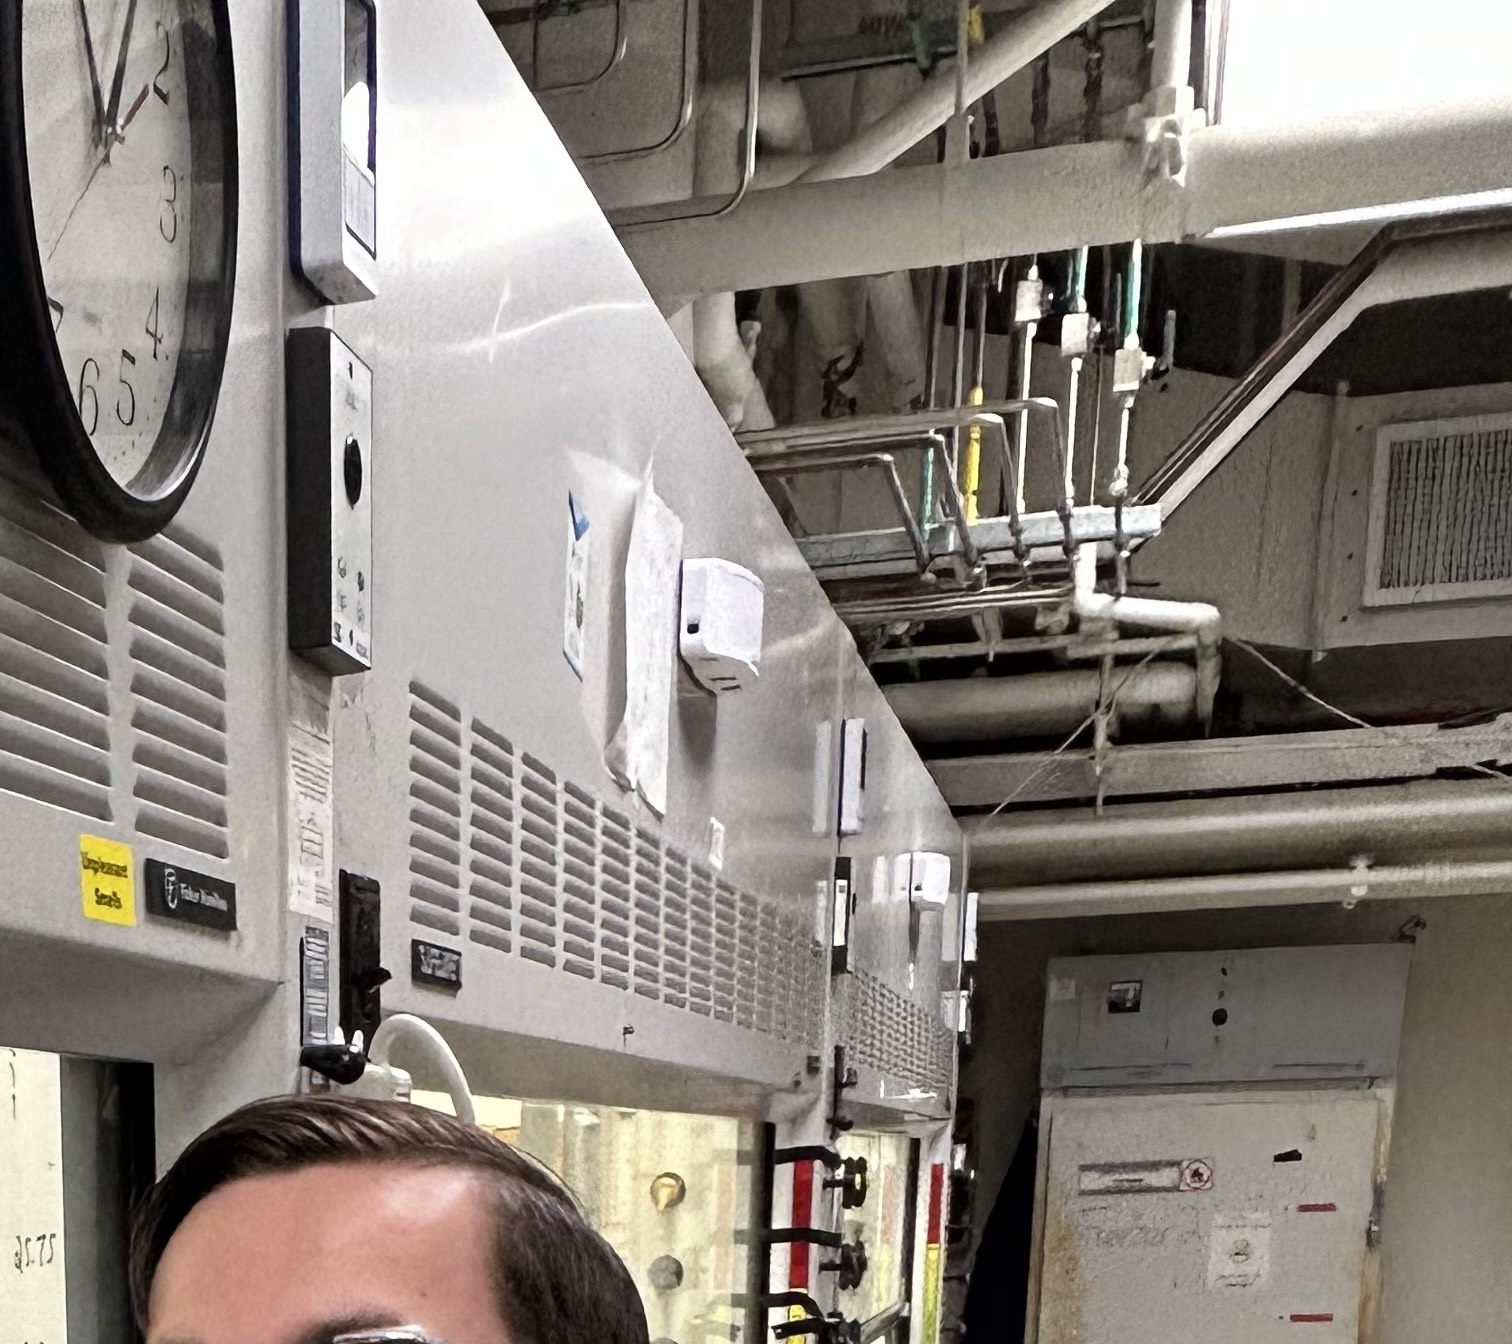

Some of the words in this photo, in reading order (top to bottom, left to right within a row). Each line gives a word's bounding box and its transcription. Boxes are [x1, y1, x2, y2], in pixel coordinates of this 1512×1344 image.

[153, 20, 170, 106] 2
[159, 165, 177, 243] 3
[145, 286, 164, 361] 4
[78, 358, 100, 437] 6
[117, 348, 136, 426] 5
